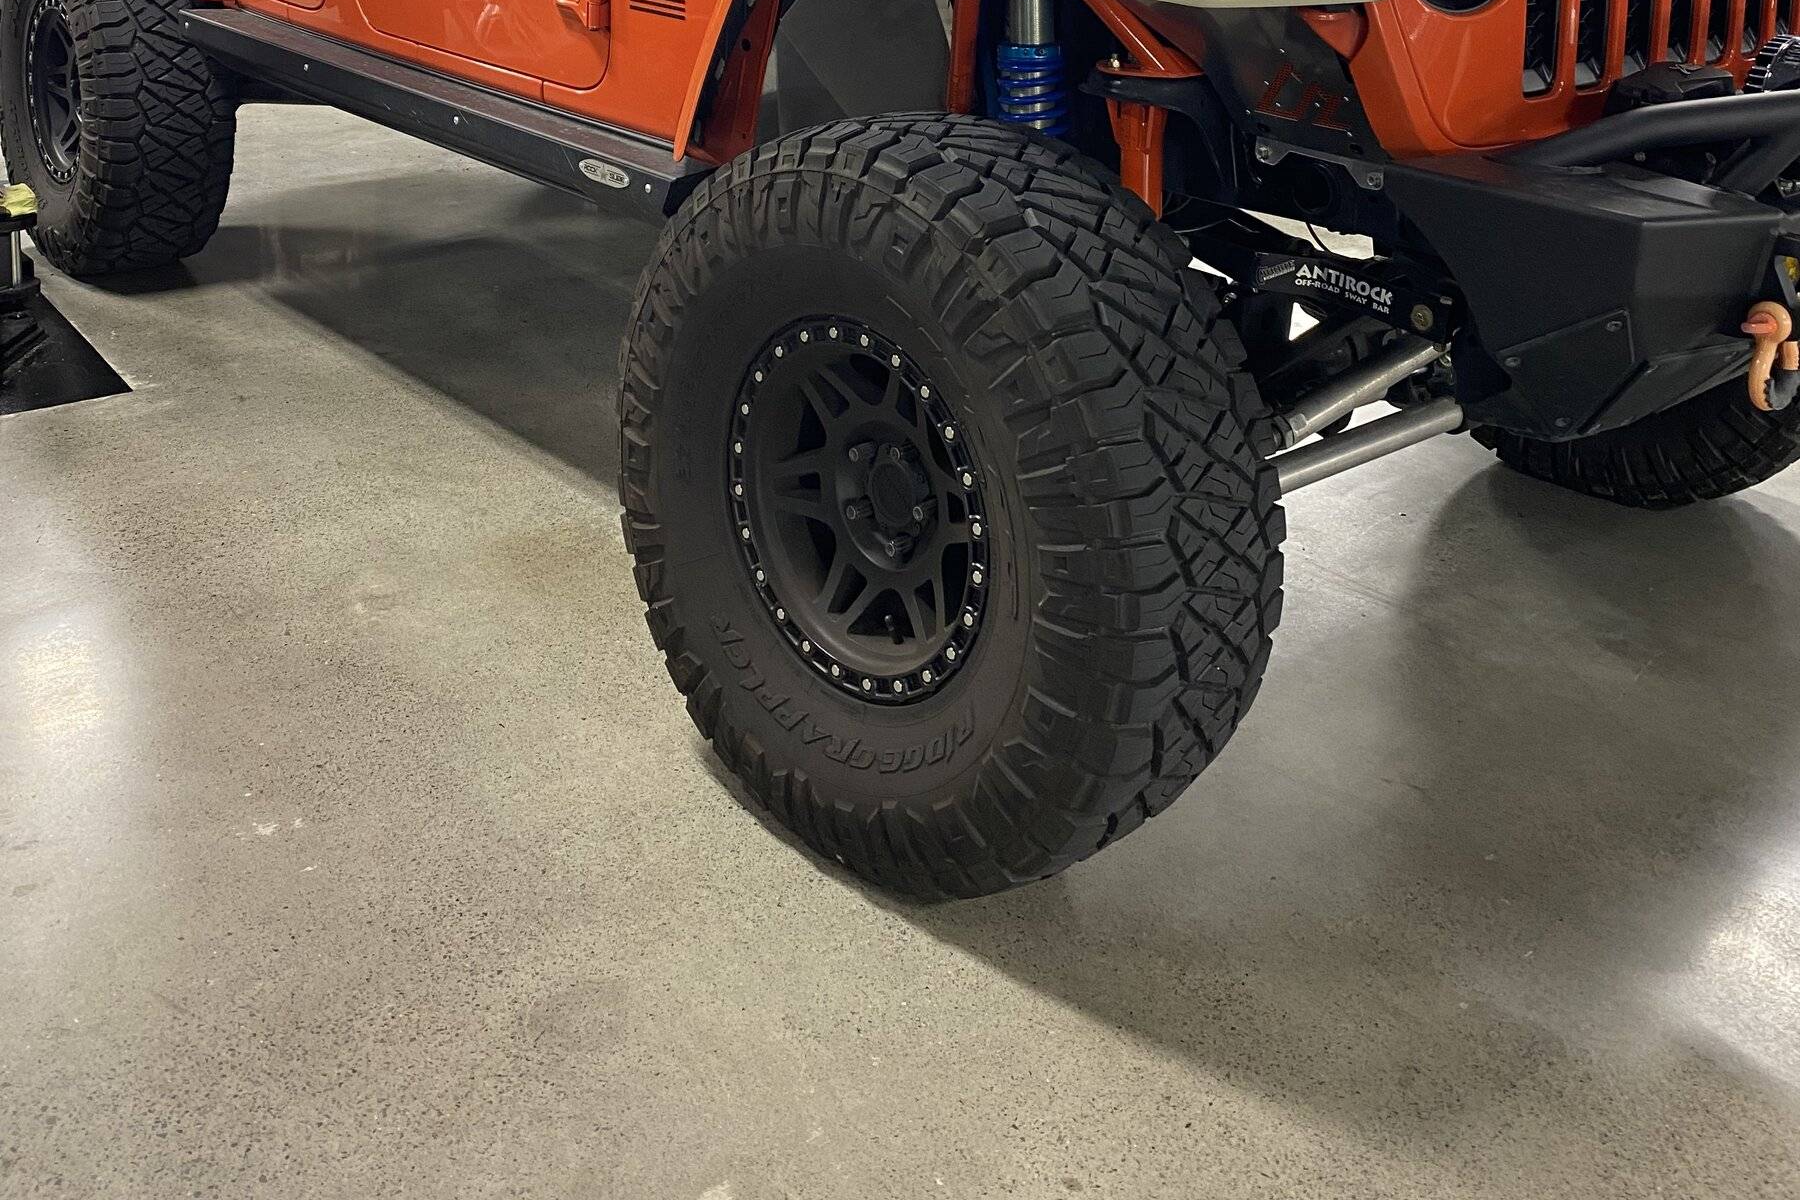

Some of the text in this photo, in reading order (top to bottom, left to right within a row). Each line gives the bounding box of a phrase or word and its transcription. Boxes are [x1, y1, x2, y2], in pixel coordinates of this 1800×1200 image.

[1295, 264, 1393, 304] ANTIROCK
[1295, 278, 1390, 315] OFF-ROAD SWAY BAR
